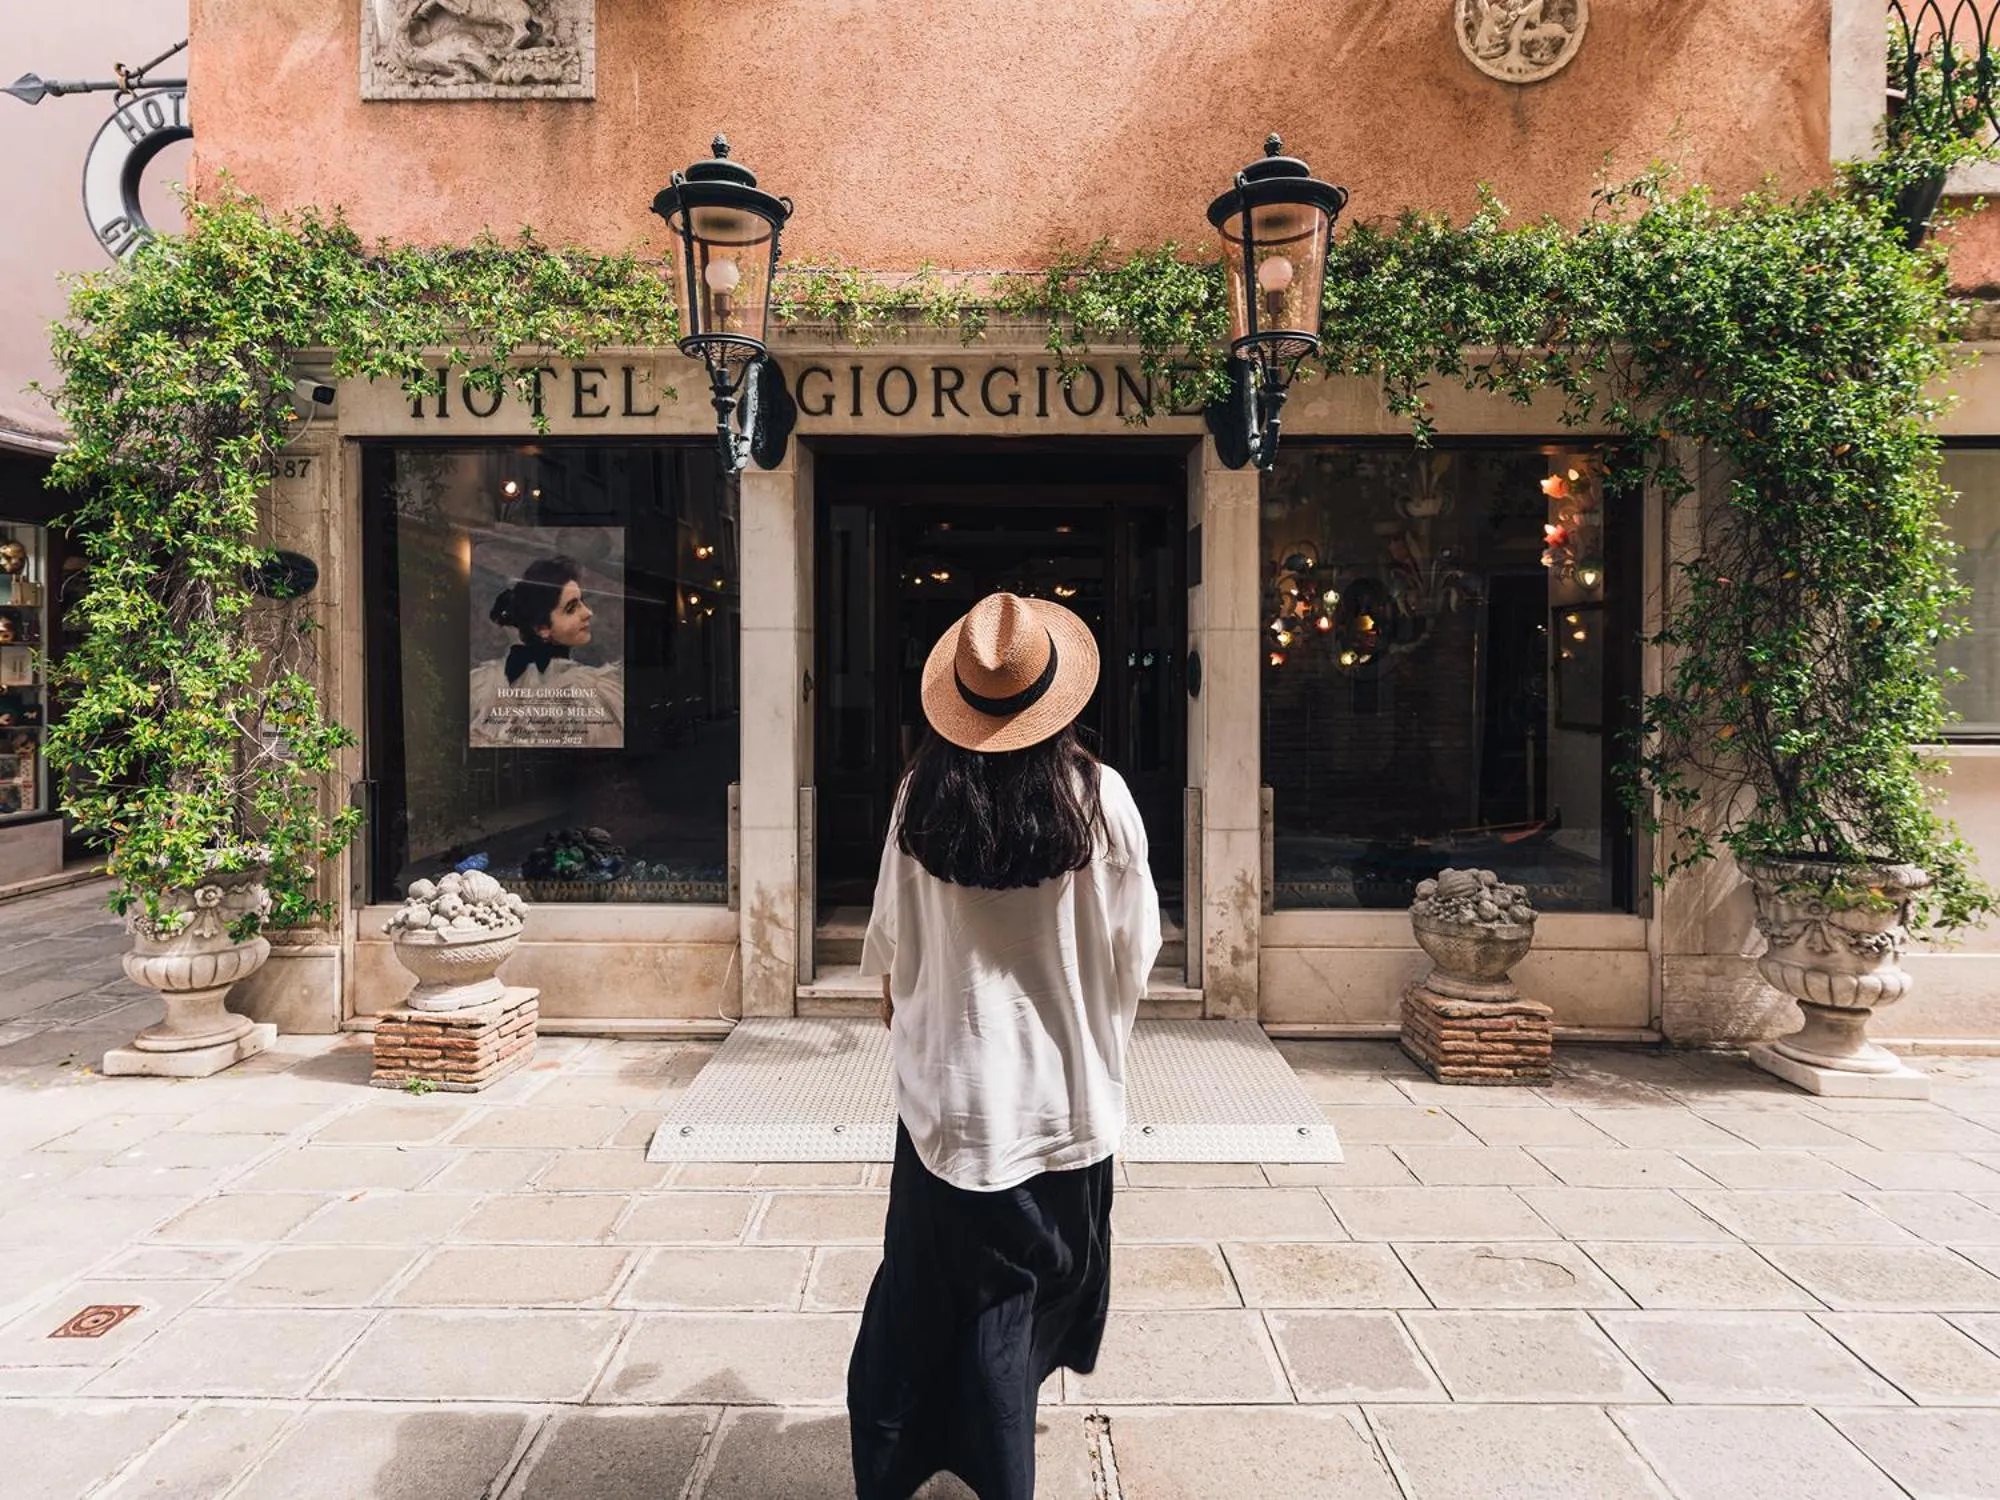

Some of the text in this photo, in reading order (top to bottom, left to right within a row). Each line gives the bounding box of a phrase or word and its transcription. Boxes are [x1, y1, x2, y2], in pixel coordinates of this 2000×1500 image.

[410, 366, 660, 418] HOTEL
[497, 688, 597, 698] HOTEL GIORGIONE
[490, 706, 605, 717] ALESSANDRO MILESI
